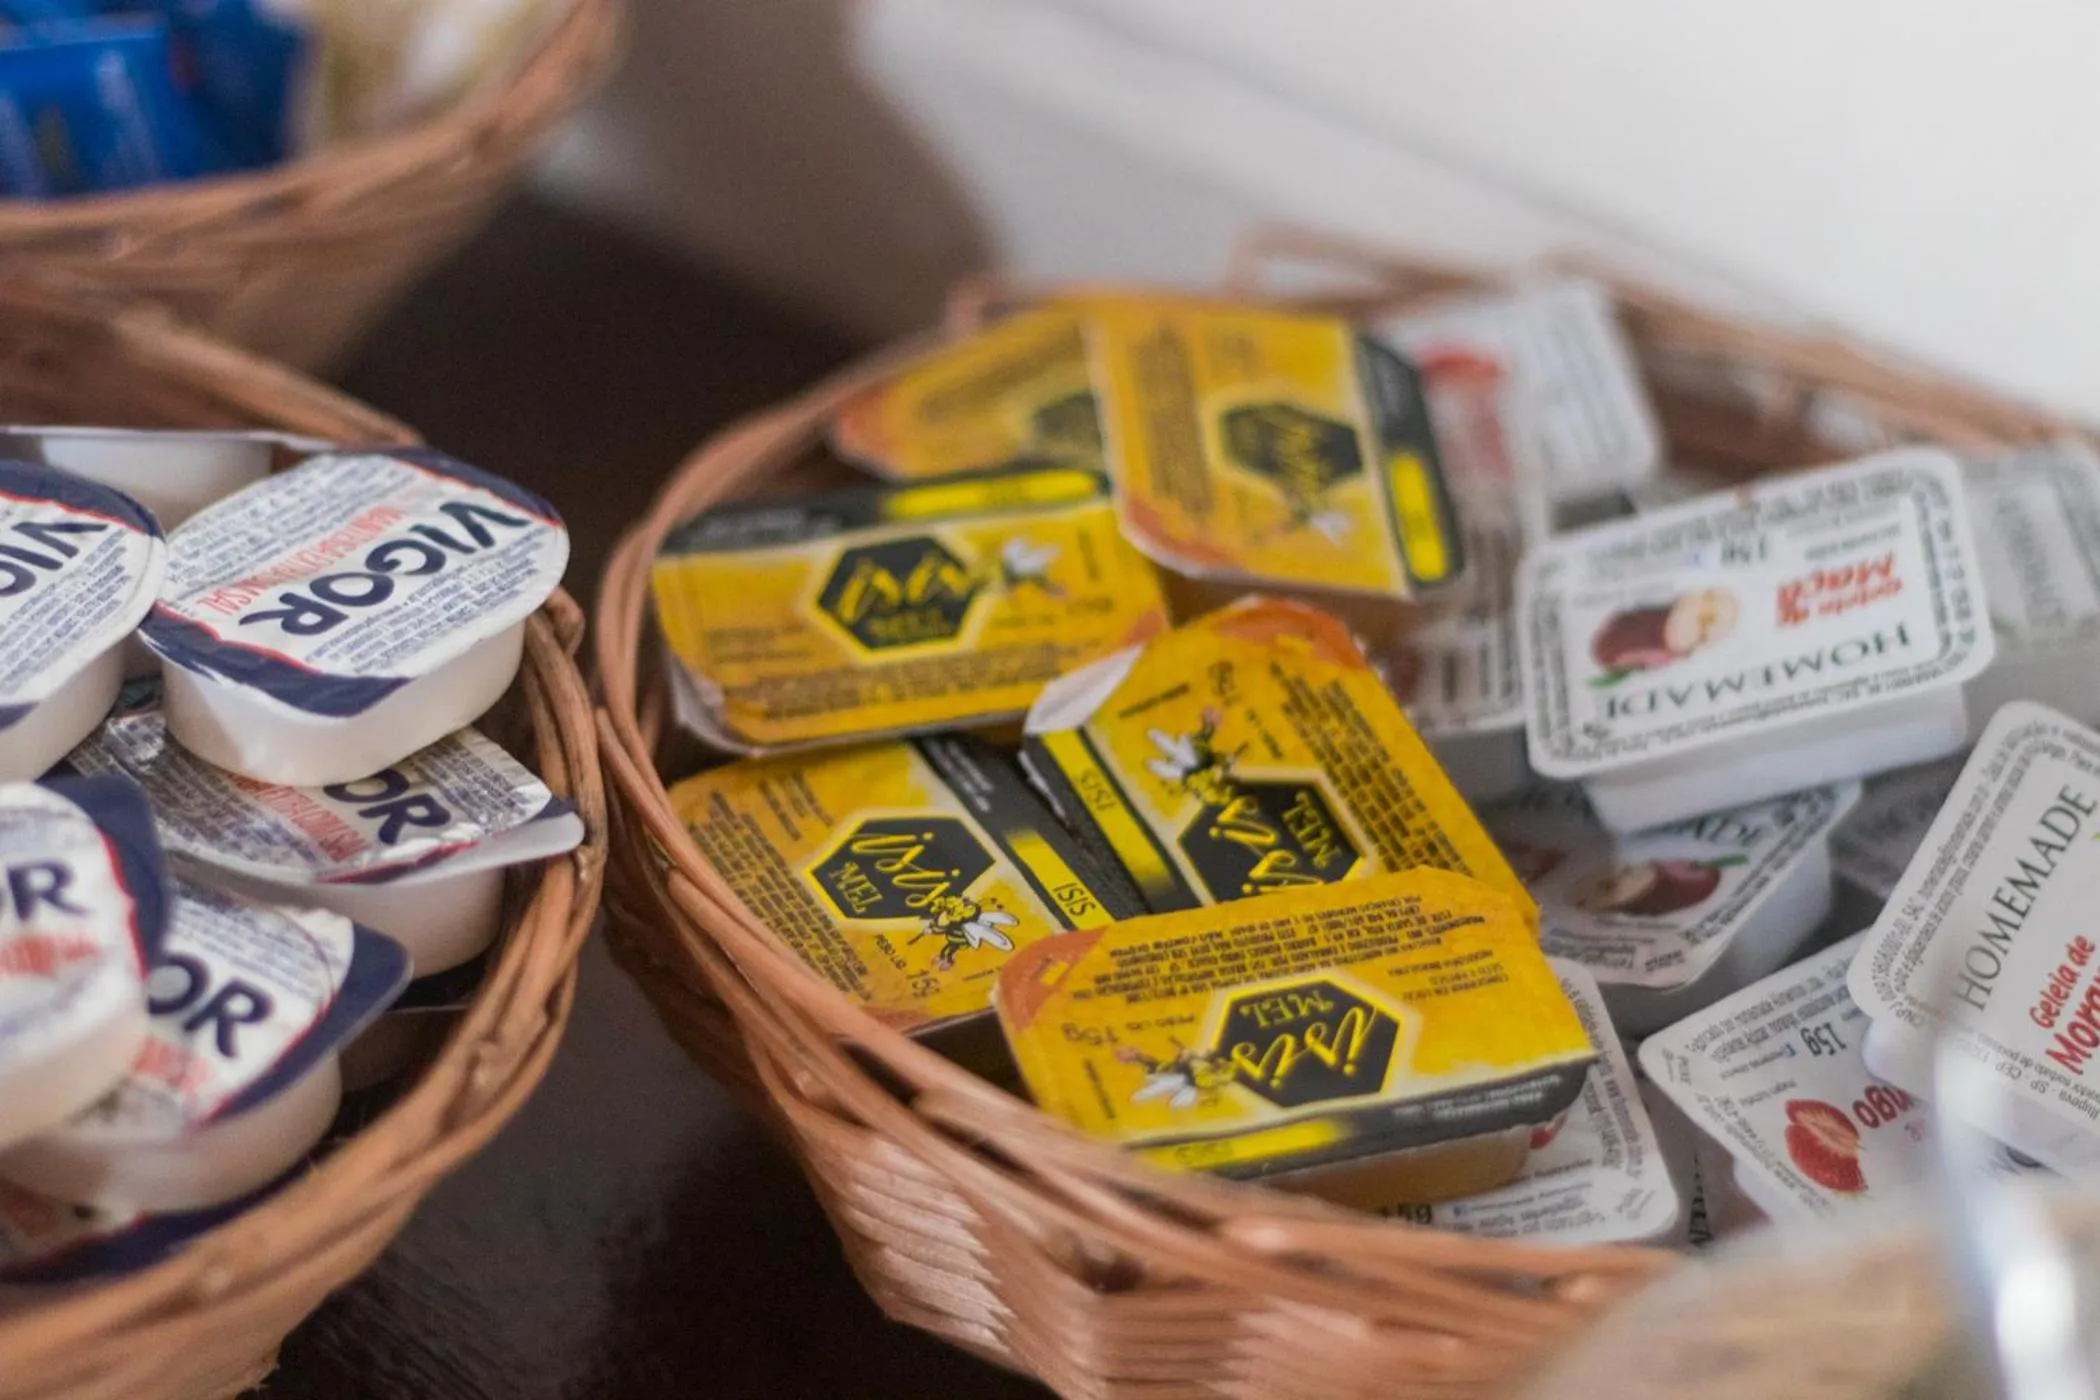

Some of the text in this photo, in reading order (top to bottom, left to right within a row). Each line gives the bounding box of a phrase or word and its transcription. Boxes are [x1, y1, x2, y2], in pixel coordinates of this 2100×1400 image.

[239, 502, 535, 637] VIGOR
[1280, 792, 1341, 868] MEL
[828, 859, 869, 914] MEL
[851, 831, 963, 907] isis
[1052, 881, 1096, 922] ISIS
[1955, 783, 2098, 1011] HOMEMADE
[1241, 992, 1334, 1029] MEL
[2029, 963, 2081, 1029] Geleia
[2065, 934, 2096, 967] de
[1231, 1005, 1377, 1088] isis
[1800, 1022, 1846, 1056] 15g
